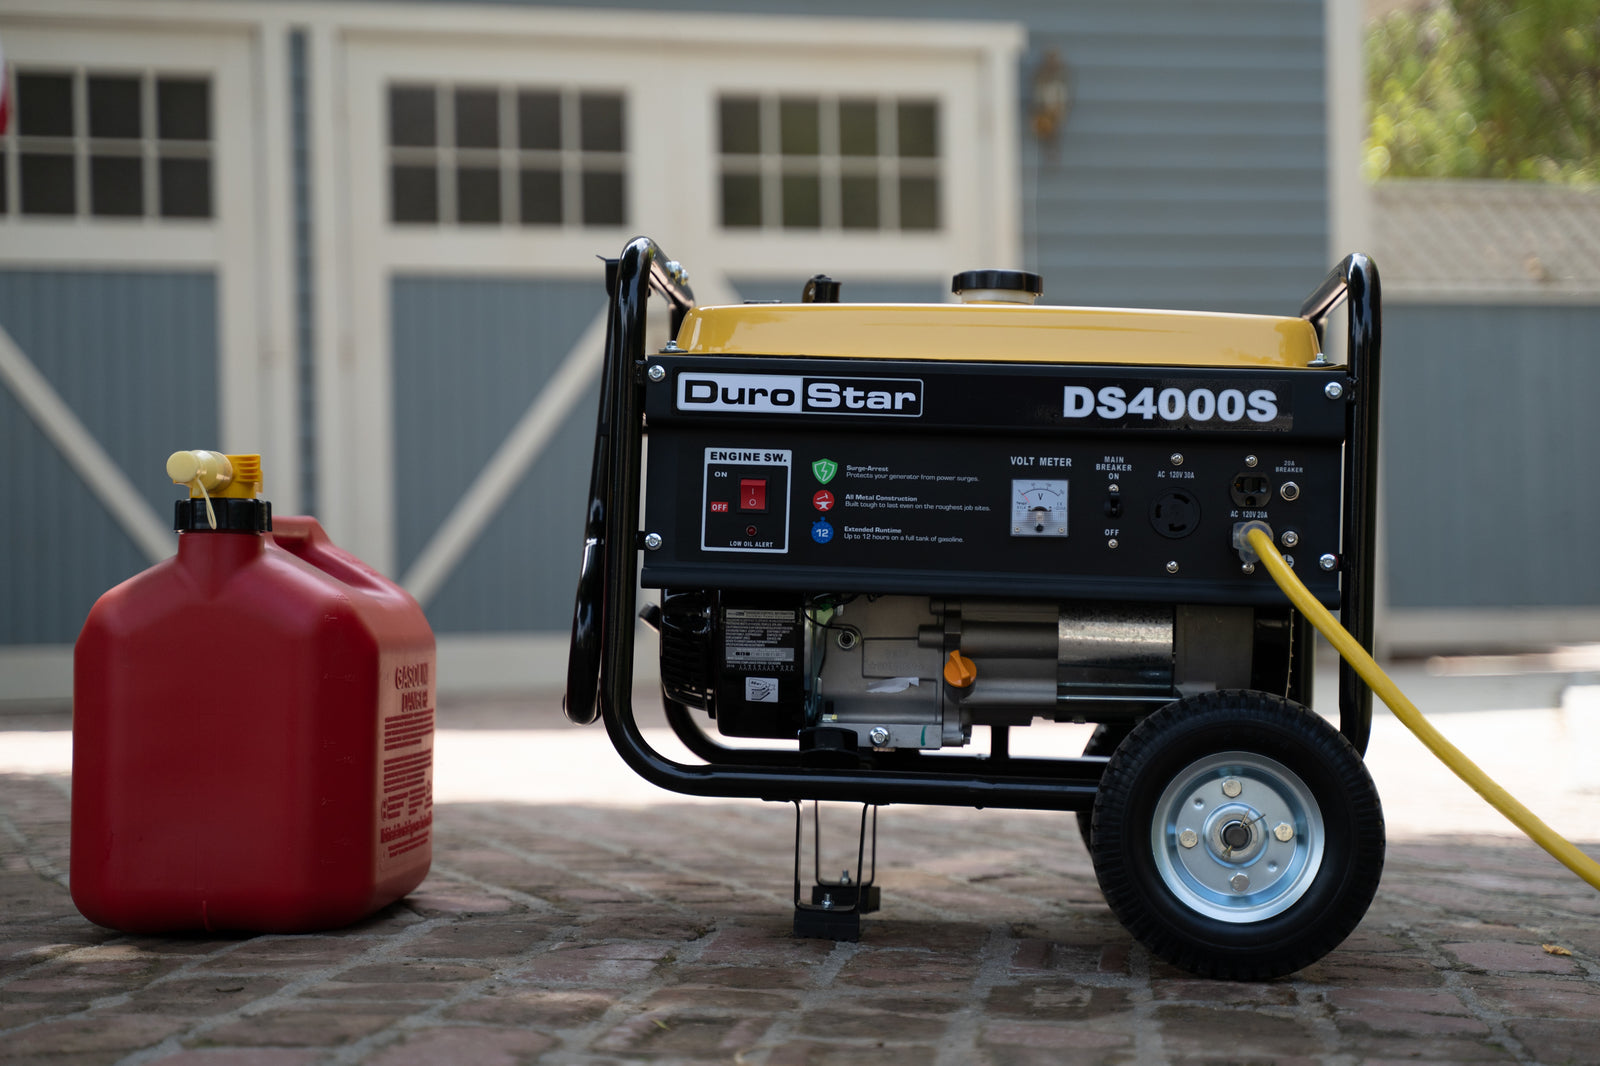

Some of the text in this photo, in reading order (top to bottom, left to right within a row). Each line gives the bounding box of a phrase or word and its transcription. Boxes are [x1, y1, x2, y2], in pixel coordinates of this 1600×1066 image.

[1064, 386, 1278, 422] DS4000S
[711, 452, 786, 462] ENGINE SW.
[1010, 456, 1072, 466] VOLT METER
[816, 529, 828, 537] 12
